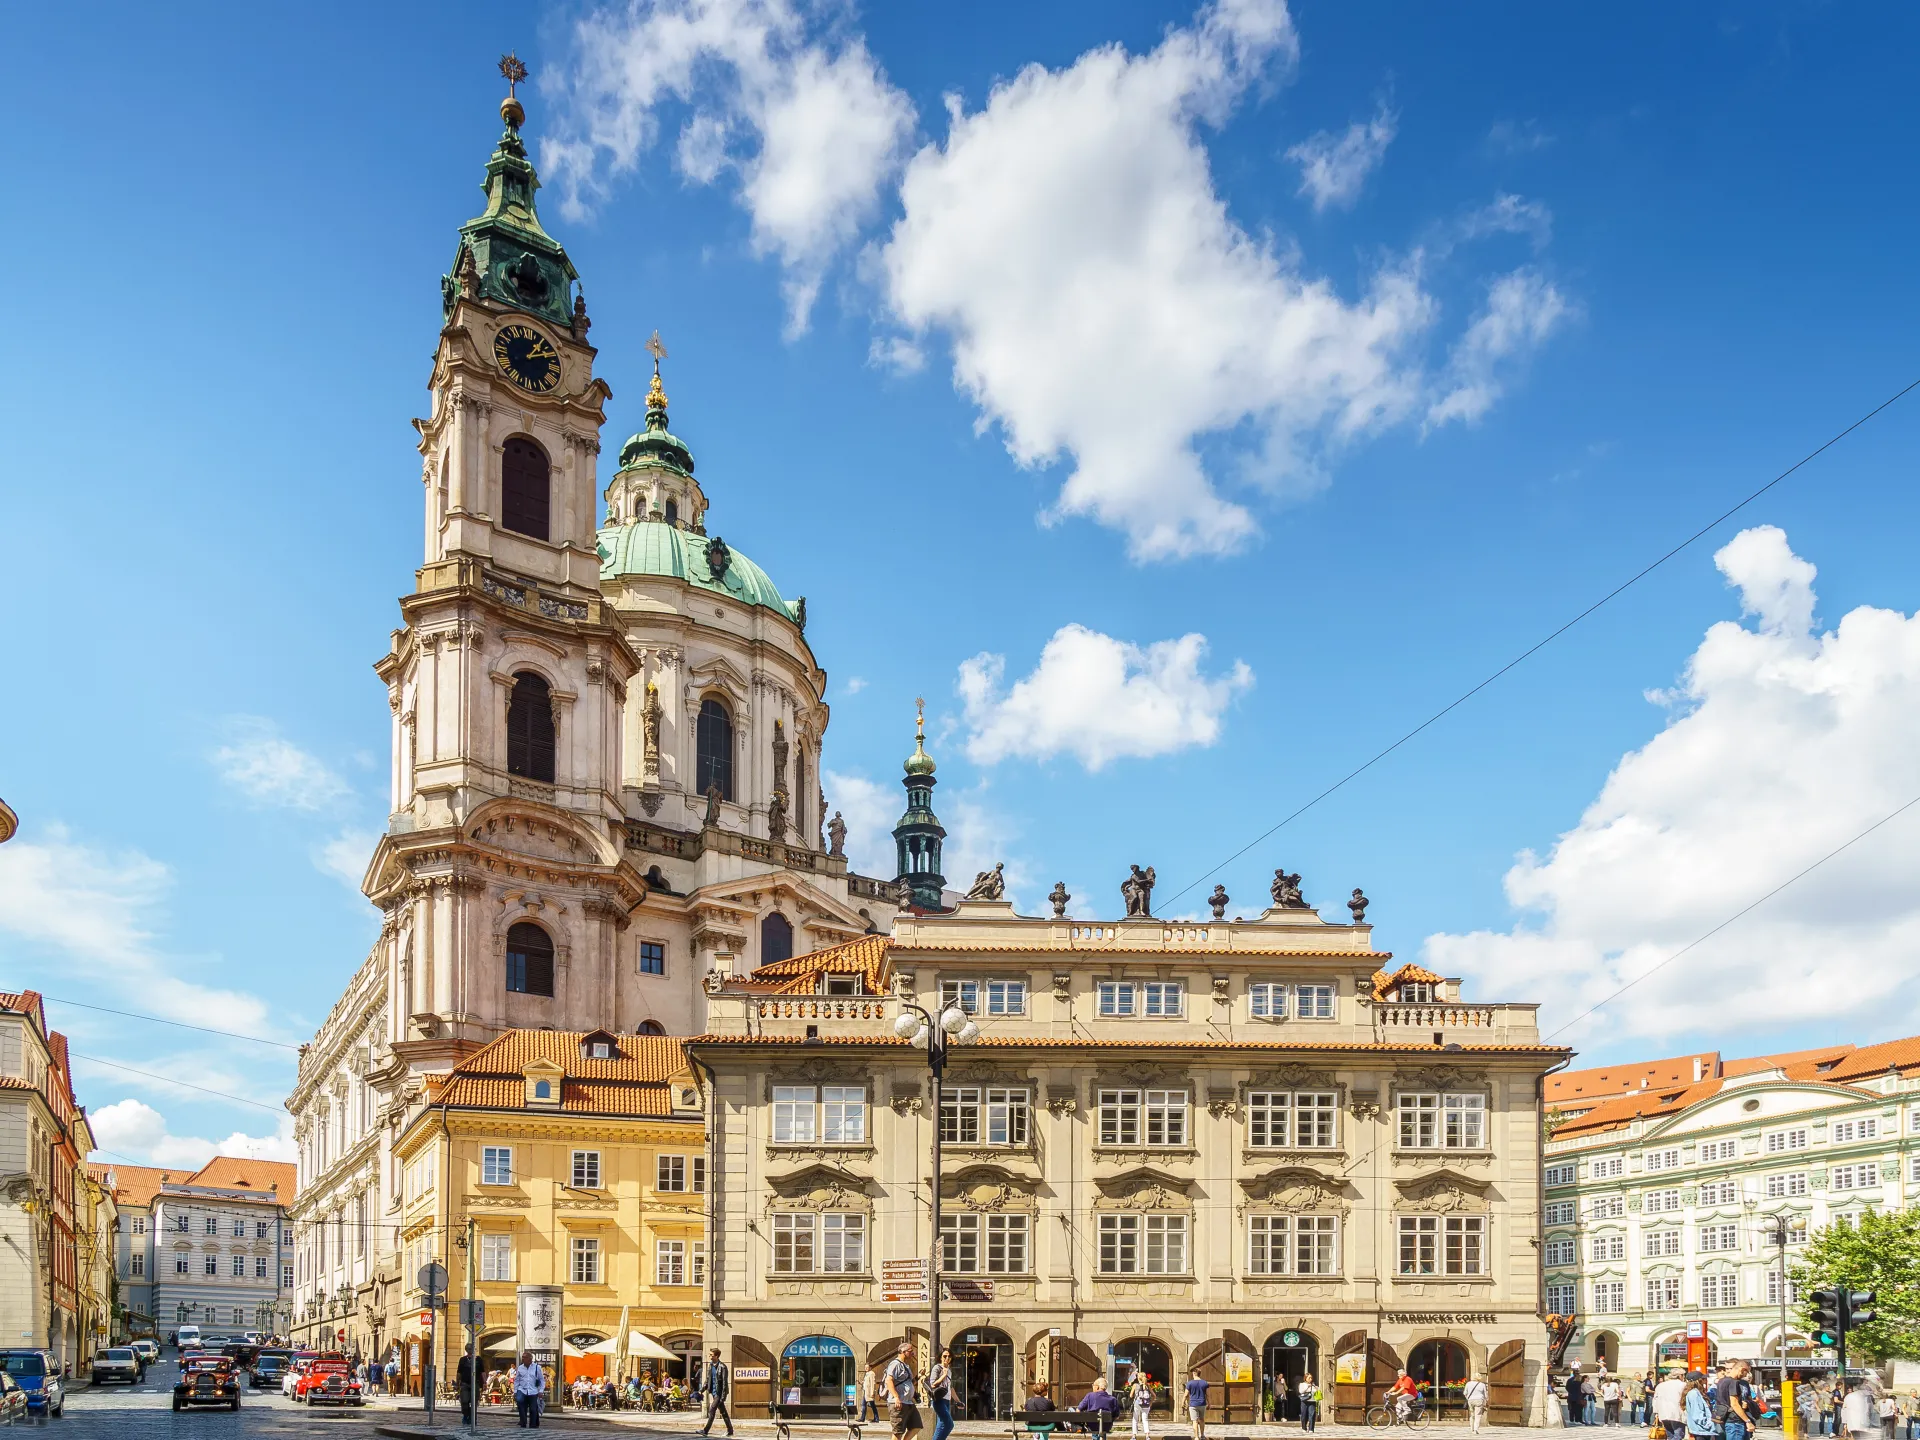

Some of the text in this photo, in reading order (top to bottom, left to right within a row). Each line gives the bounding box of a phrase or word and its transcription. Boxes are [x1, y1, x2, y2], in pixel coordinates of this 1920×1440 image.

[523, 327, 532, 340] XII
[422, 1314, 432, 1324] illy
[1387, 1313, 1497, 1322] STARBUCKS COFFEE
[790, 1345, 848, 1354] CHANGE
[735, 1370, 769, 1378] CHANGE
